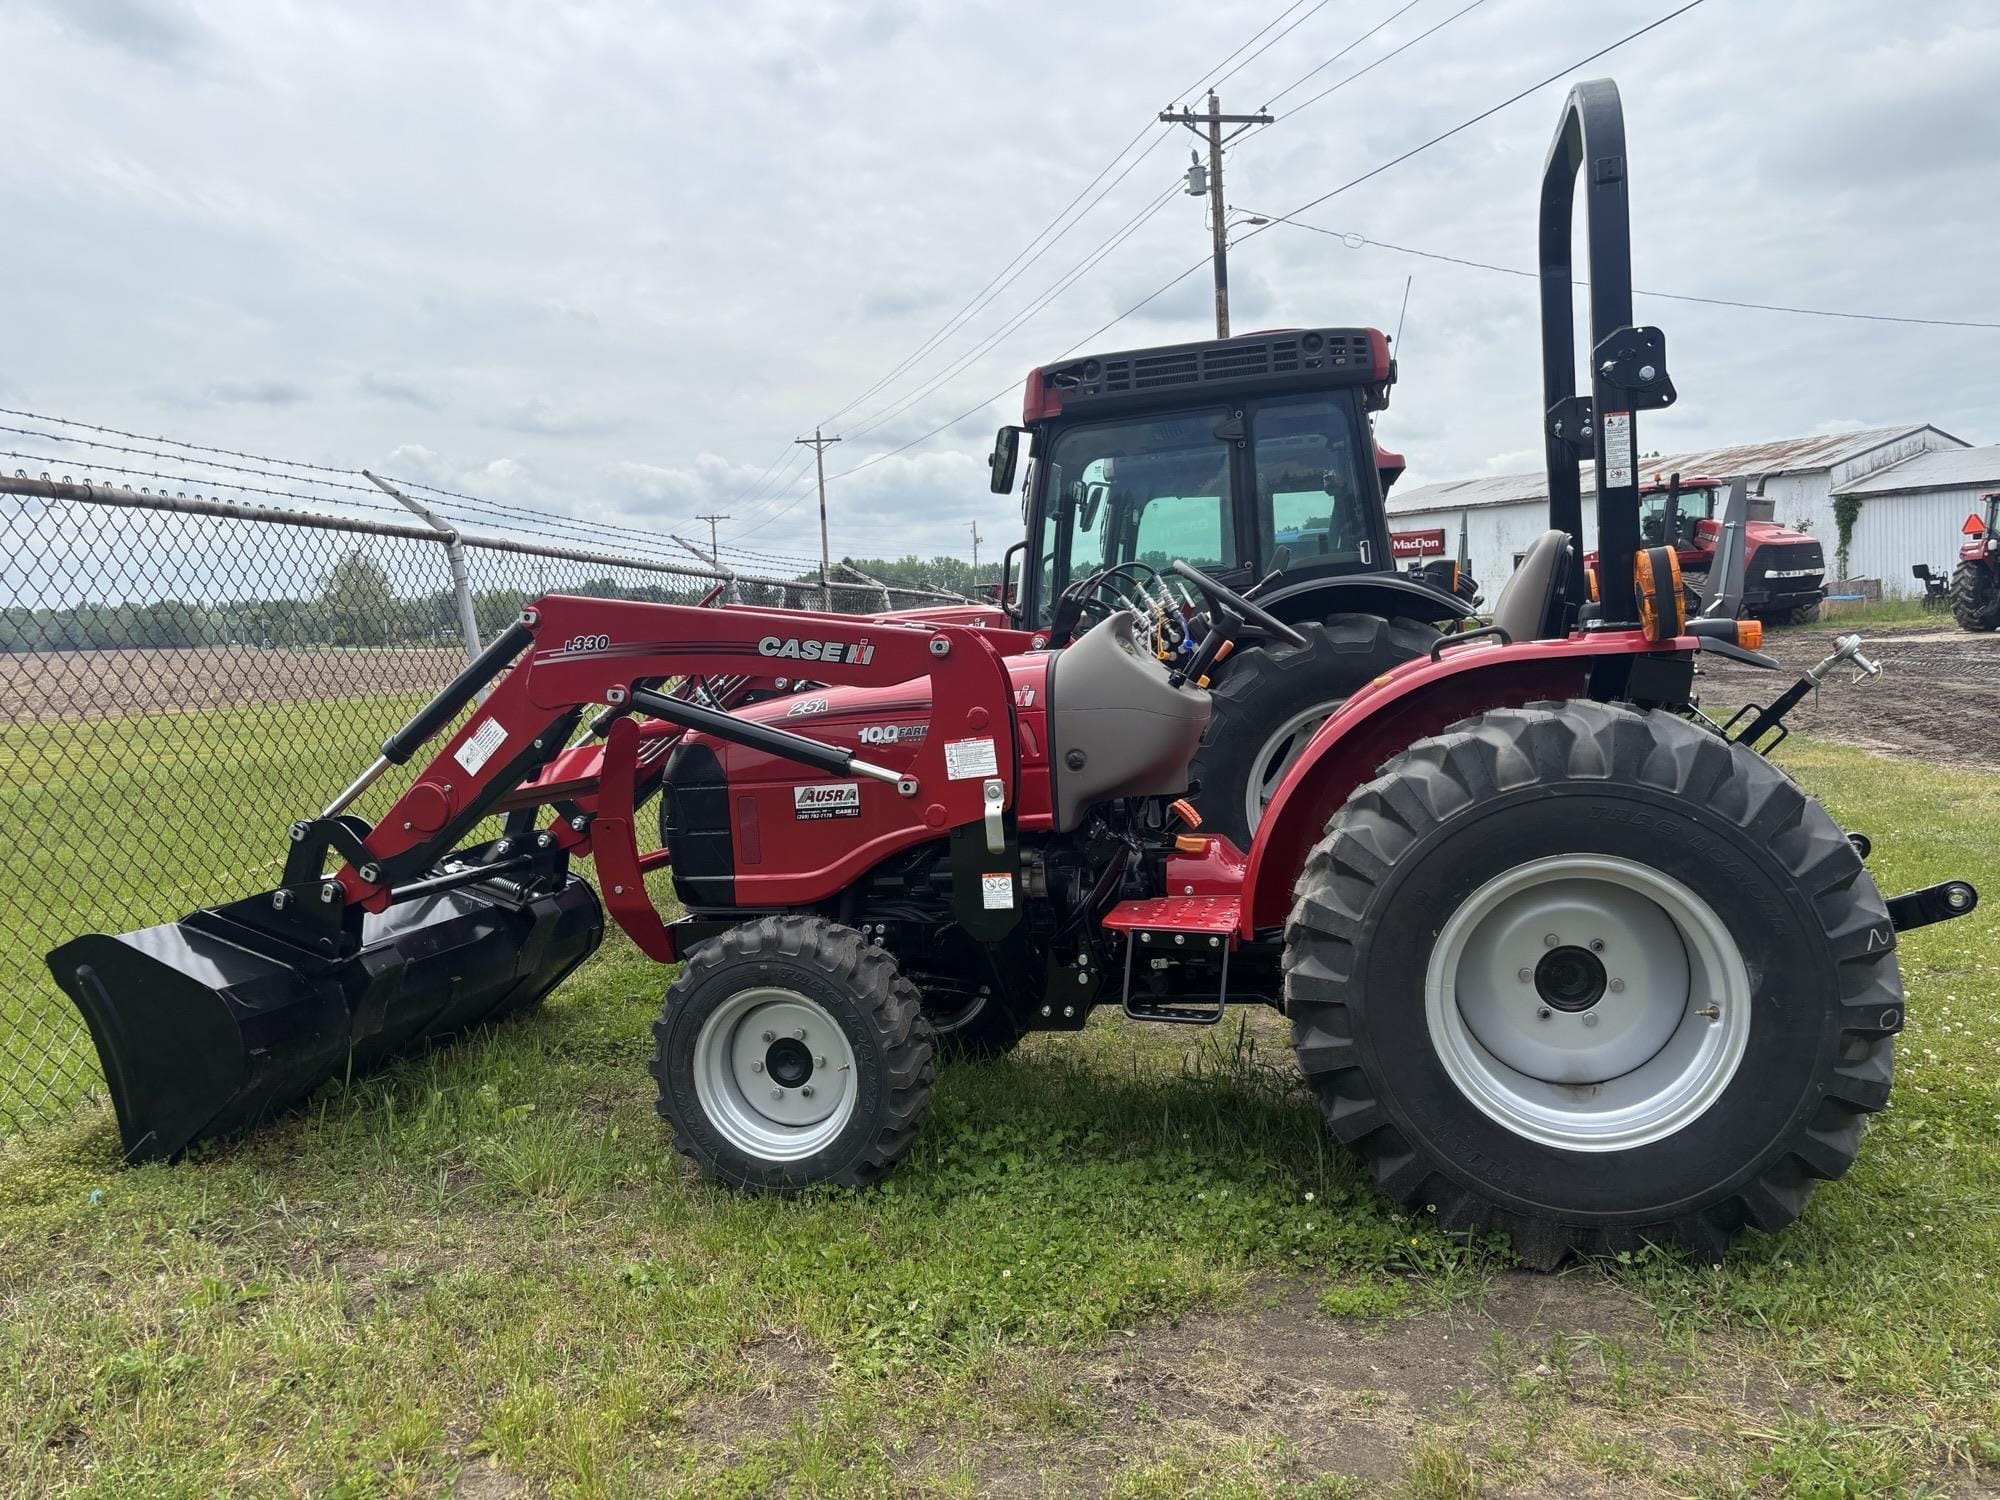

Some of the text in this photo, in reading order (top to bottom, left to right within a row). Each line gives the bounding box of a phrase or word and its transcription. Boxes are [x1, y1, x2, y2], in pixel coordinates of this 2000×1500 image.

[1393, 538, 1439, 550] MacDon
[565, 635, 609, 652] L330
[759, 637, 844, 662] CASE
[858, 725, 898, 743] 100
[797, 788, 857, 803] AUSRA
